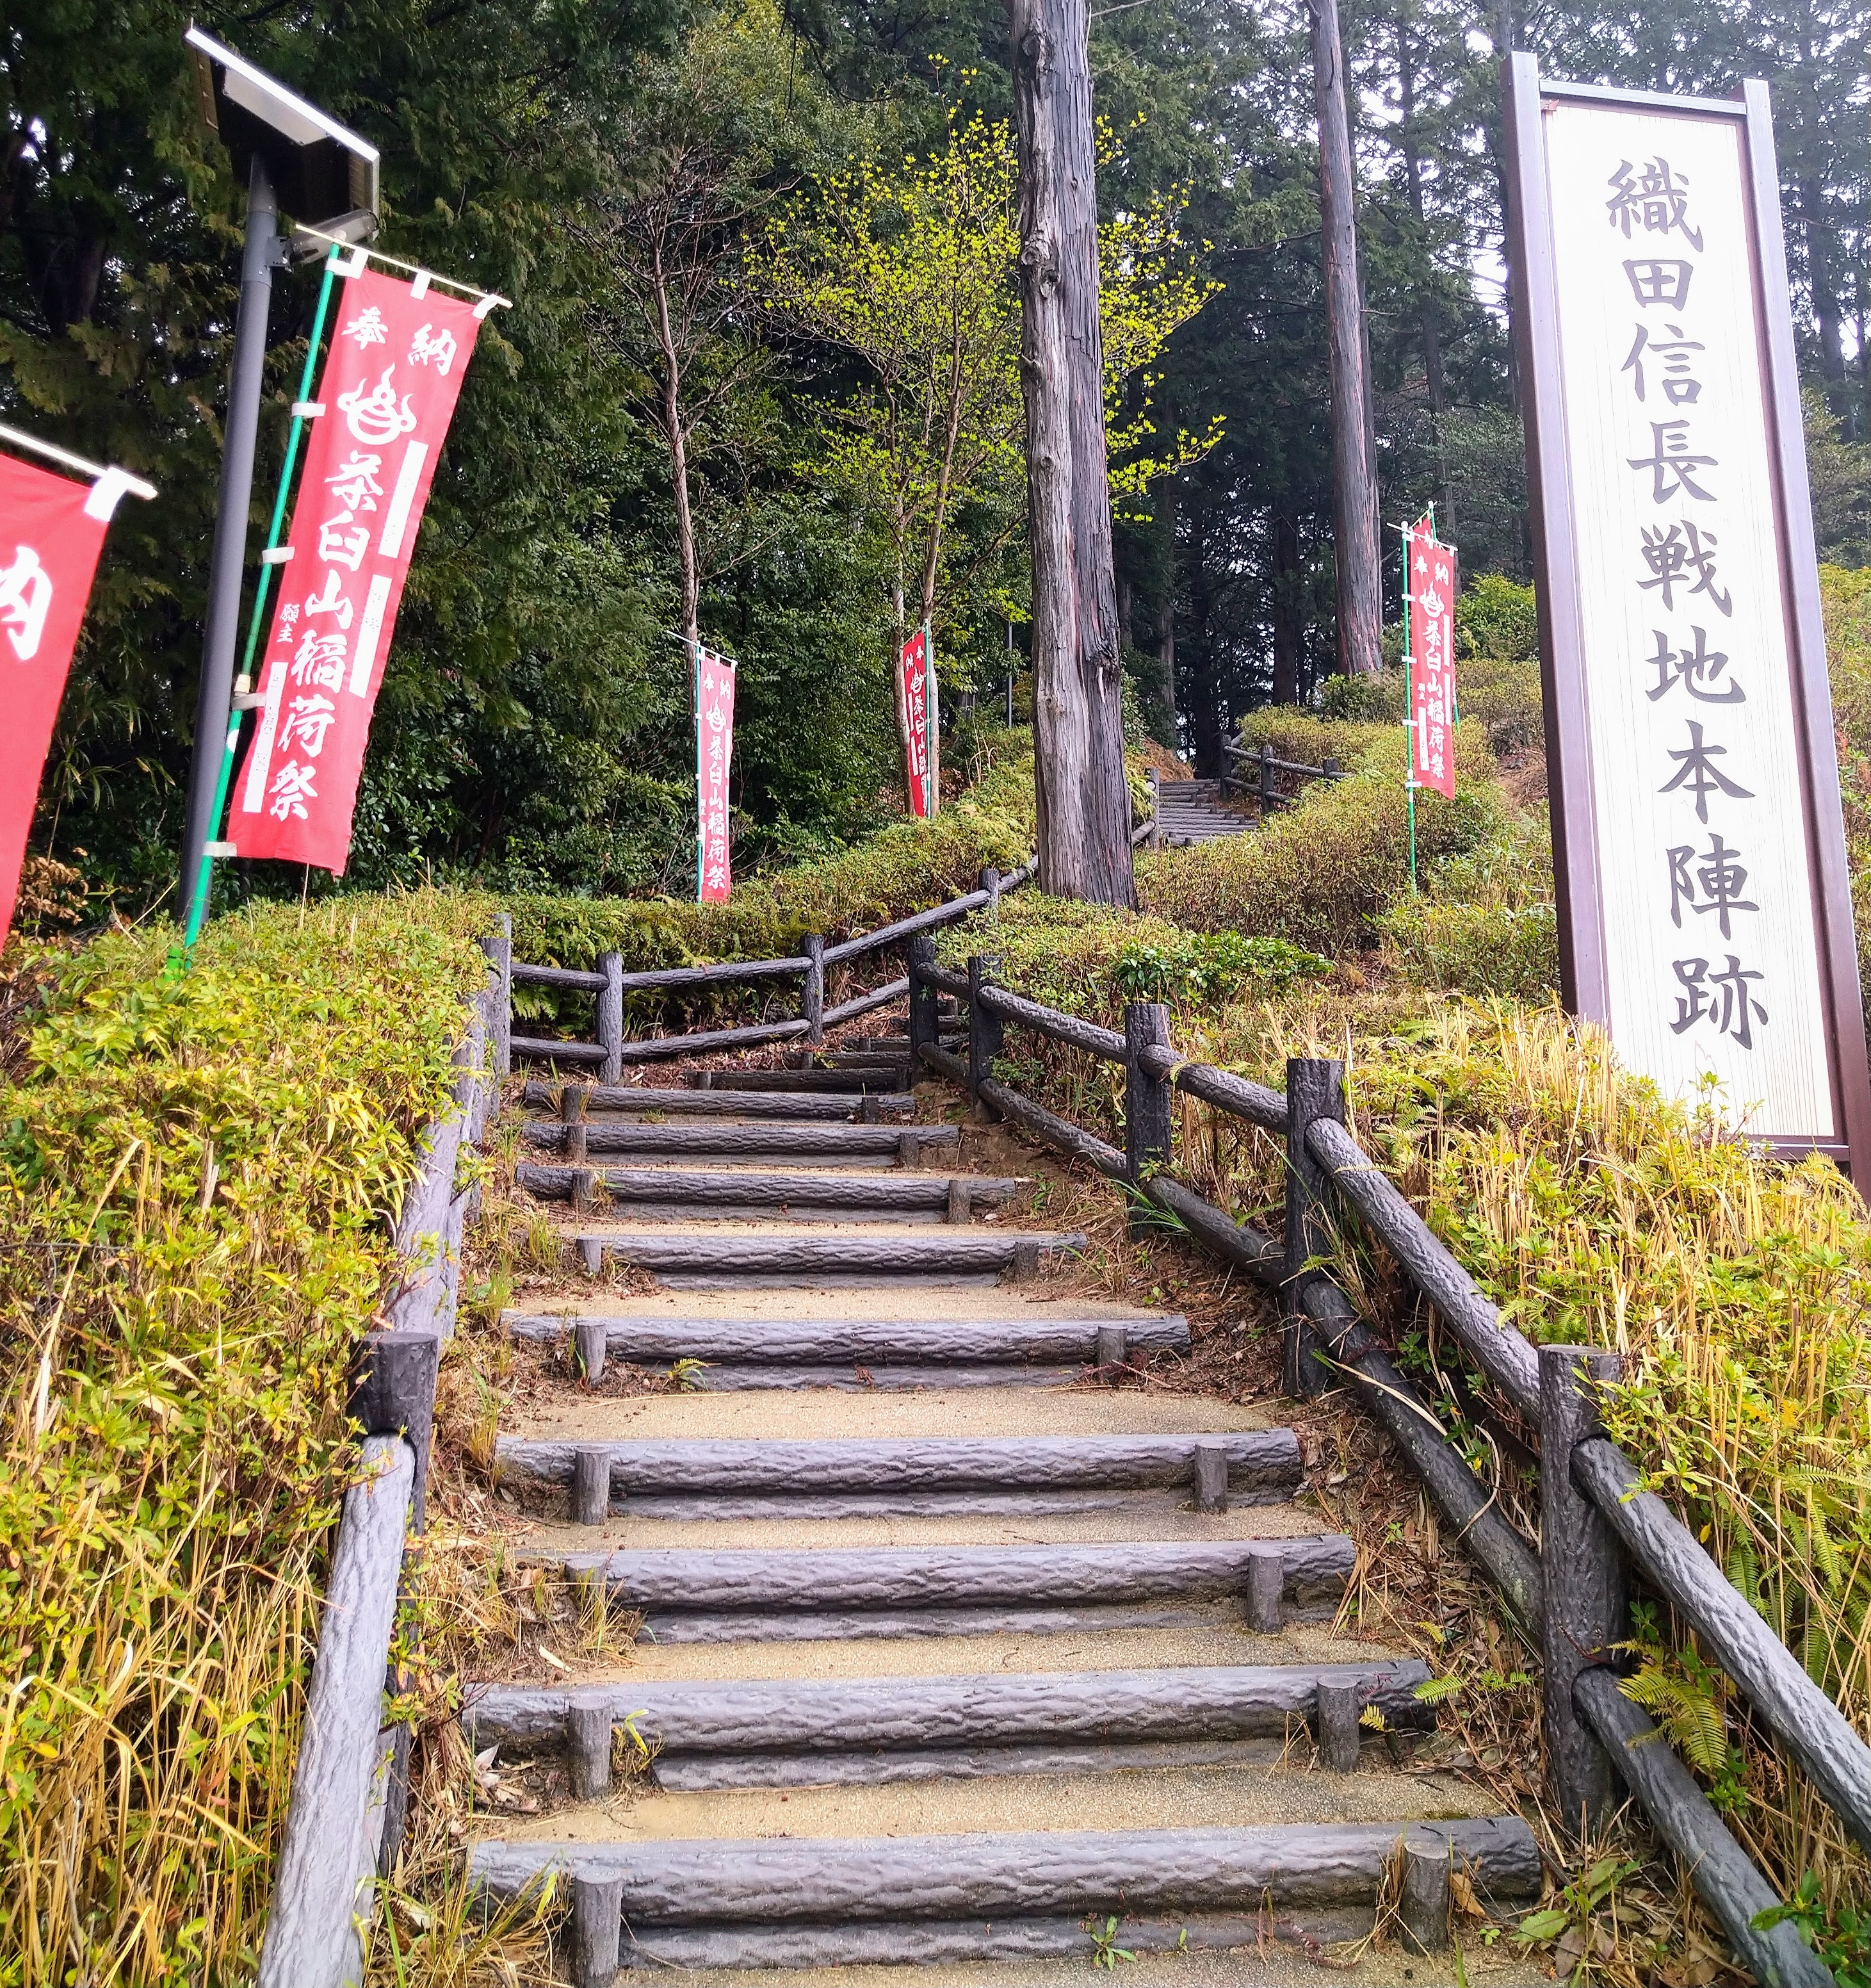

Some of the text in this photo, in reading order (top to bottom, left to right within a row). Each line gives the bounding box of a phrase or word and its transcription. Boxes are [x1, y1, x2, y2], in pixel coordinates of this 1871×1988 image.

[341, 306, 457, 376] 奉納
[268, 450, 384, 822] 茶臼山稲荷祭
[277, 603, 301, 644] 願主
[1606, 156, 1769, 1050] 織田信長戦地本陣跡
[1422, 619, 1445, 779] 茶臼山稲荷祭
[706, 735, 726, 890] 茶臼山稲荷祭
